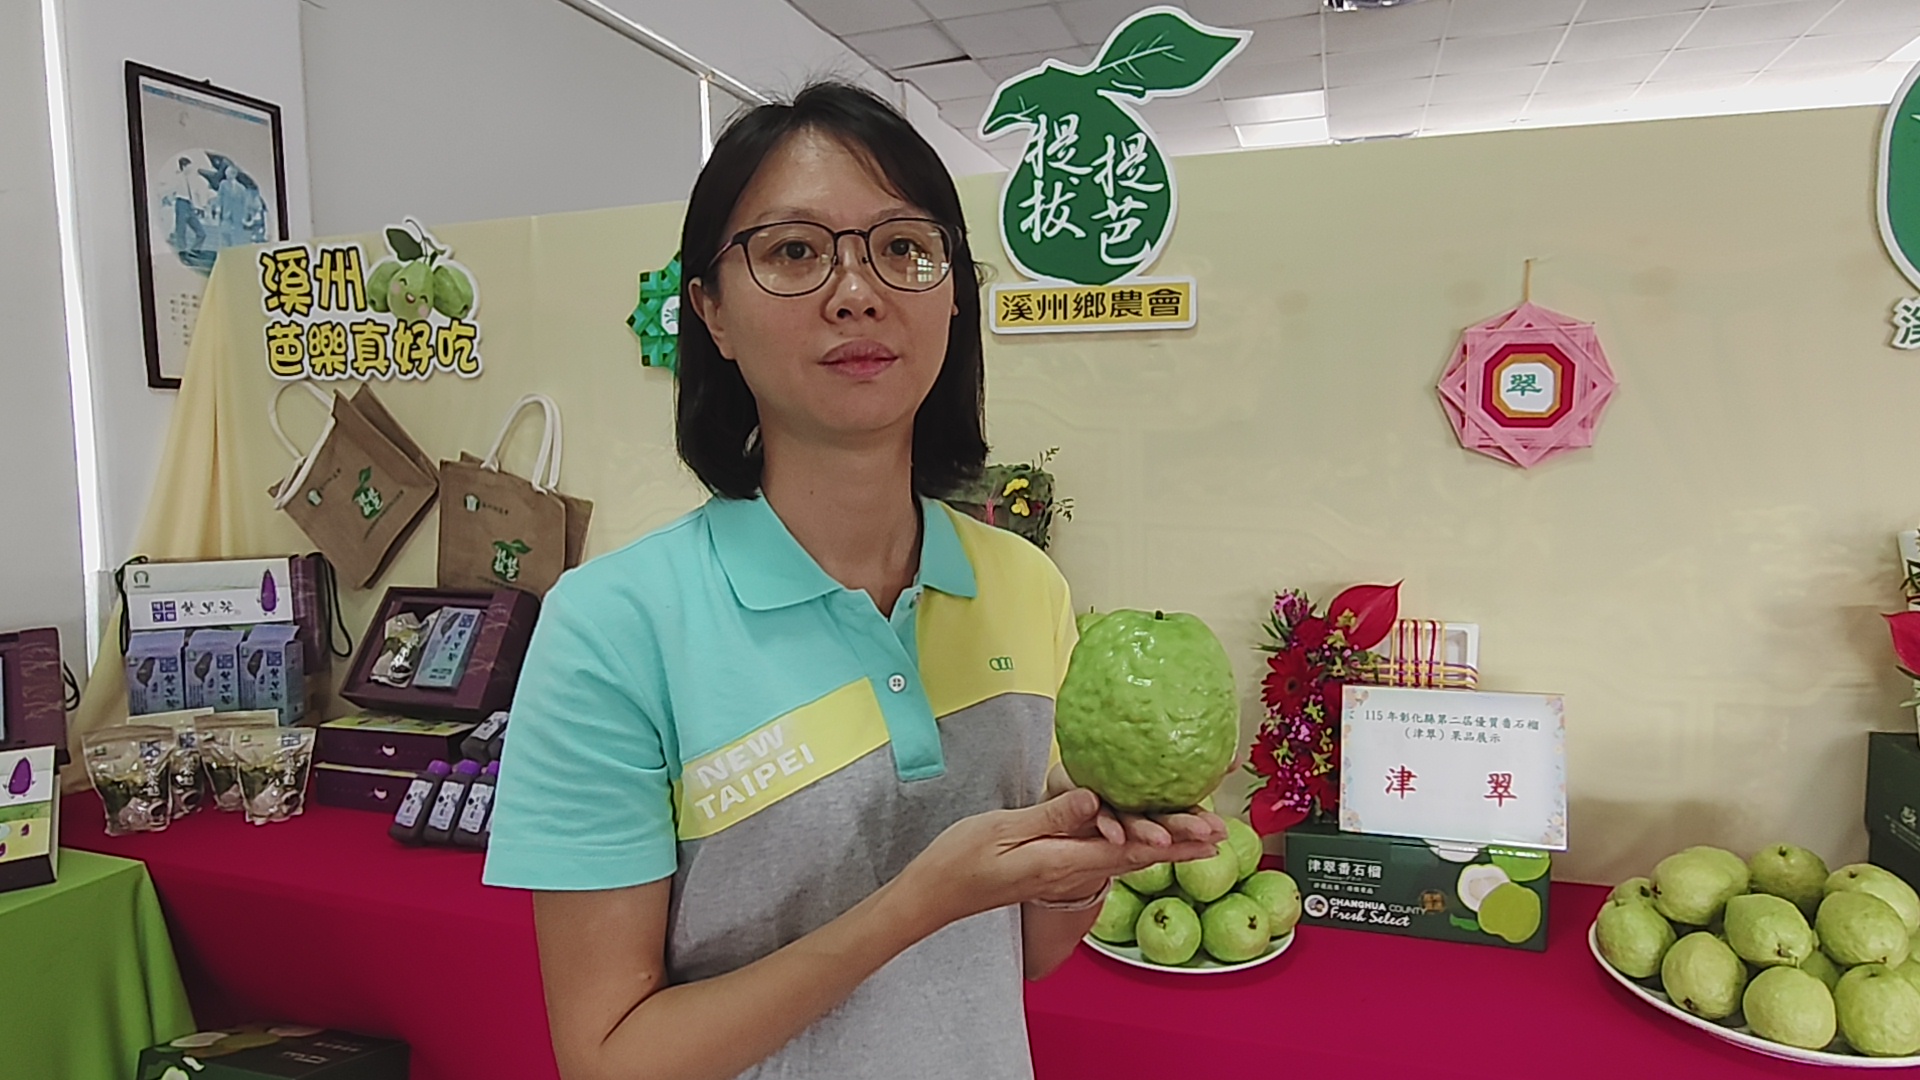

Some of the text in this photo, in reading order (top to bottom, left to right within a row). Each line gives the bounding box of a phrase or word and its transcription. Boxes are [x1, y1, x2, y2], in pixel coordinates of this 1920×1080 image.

[260, 246, 367, 317] 溪州
[1001, 288, 1182, 321] 溪州鄉農會
[265, 317, 479, 376] 芭樂真好吃
[1506, 374, 1543, 396] 翠
[1365, 710, 1383, 721] 115
[696, 724, 785, 789] NEW
[695, 743, 815, 820] TAIPEI
[1385, 765, 1517, 808] 津 翠
[1307, 858, 1382, 879] 津翠番石榴
[1329, 898, 1428, 916] CHANGHUA COUNTY
[1329, 908, 1412, 928] Fresh Select
